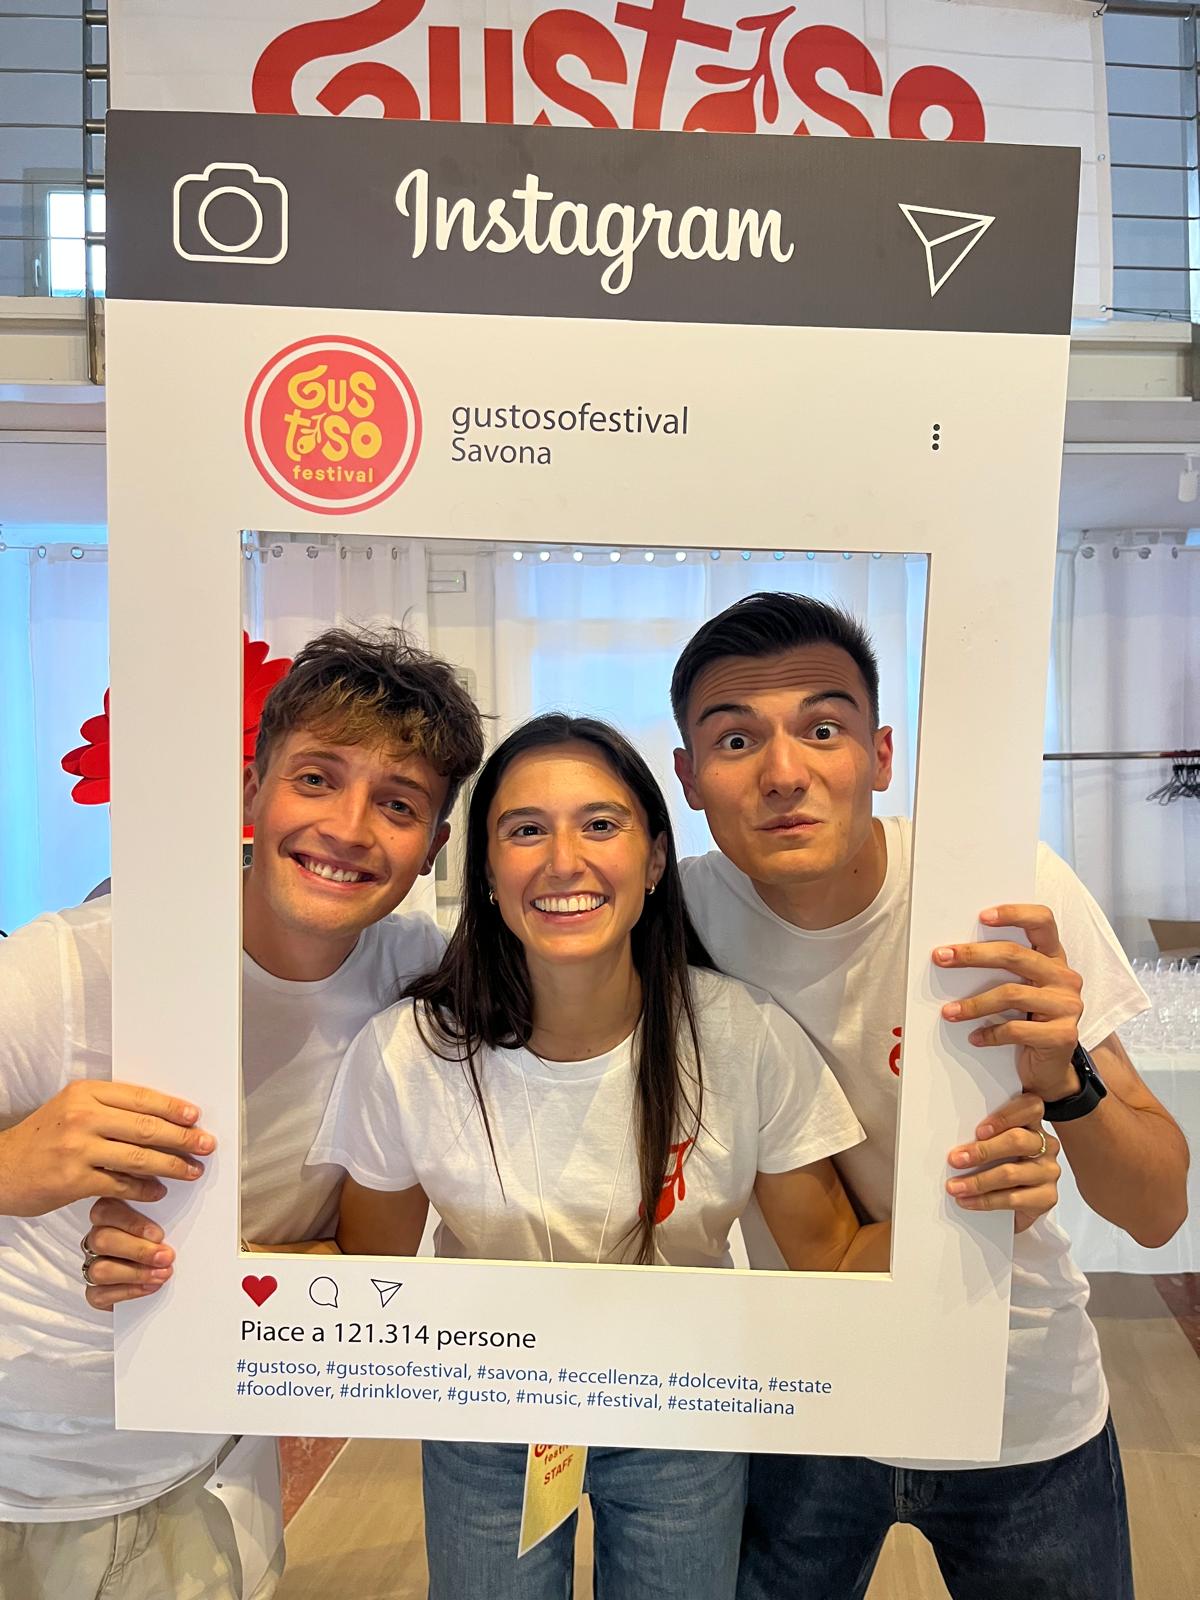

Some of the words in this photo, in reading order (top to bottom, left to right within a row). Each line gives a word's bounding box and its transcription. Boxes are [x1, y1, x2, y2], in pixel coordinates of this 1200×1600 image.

[394, 168, 796, 296] Instagram
[450, 402, 689, 435] gustosofestival
[450, 436, 552, 465] Savona
[292, 465, 374, 483] festival
[240, 1319, 305, 1343] Piace
[311, 1326, 325, 1343] a
[334, 1321, 430, 1345] 121.314
[436, 1328, 537, 1351] persone
[236, 1358, 321, 1378] #gustoso,
[325, 1360, 472, 1382] #gustosofestival,
[476, 1364, 553, 1384] #savona,
[557, 1367, 663, 1389] #eccellenza,
[667, 1371, 763, 1393] #dolcevita,
[767, 1376, 832, 1394] #estate
[236, 1379, 335, 1400] #foodlover,
[339, 1382, 442, 1403] #drinklover,
[447, 1386, 511, 1406] #gusto,
[515, 1388, 582, 1408] #music,
[586, 1390, 663, 1412] #festival,
[667, 1393, 795, 1416] #estateitaliana
[543, 1453, 575, 1486] STAFF
